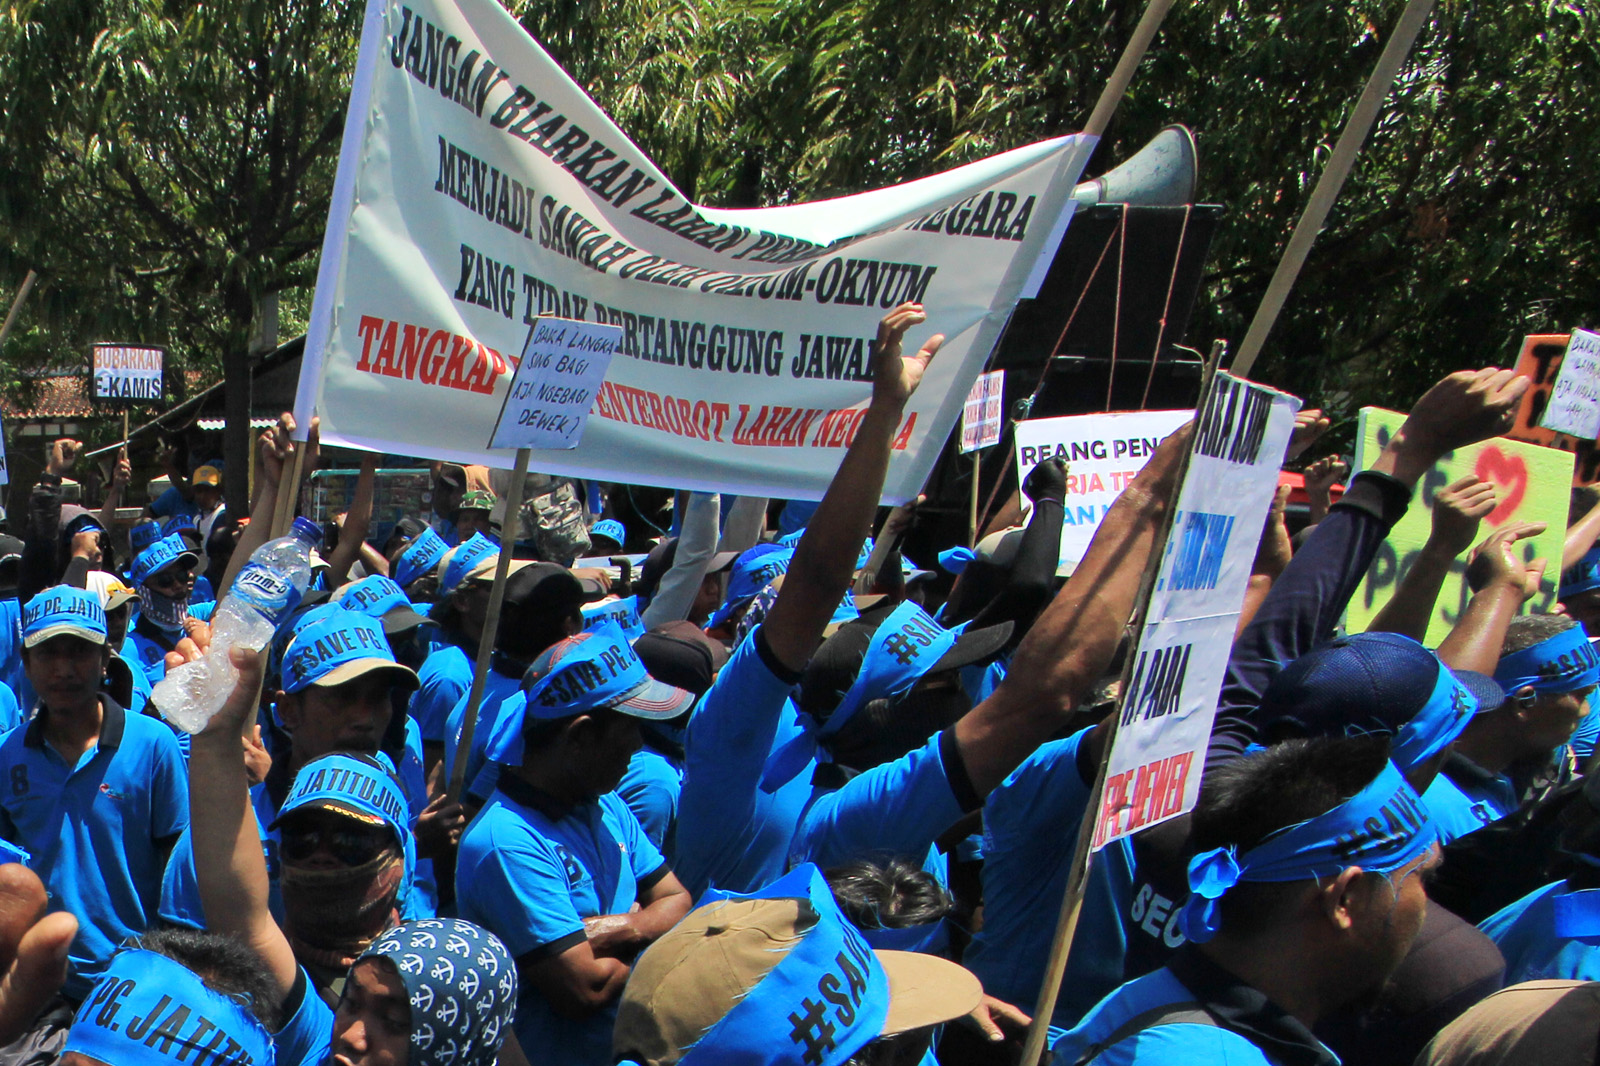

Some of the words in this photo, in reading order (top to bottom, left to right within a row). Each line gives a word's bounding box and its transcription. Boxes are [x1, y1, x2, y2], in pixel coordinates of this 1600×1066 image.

[391, 5, 510, 119] JANGAN
[490, 84, 656, 209] BIARKAN
[435, 135, 535, 239] MENJADI
[539, 195, 636, 275] SAWAH
[454, 243, 516, 319] YANG
[94, 347, 162, 369] BUBARKAN
[534, 325, 566, 346] BAKA
[567, 331, 615, 356] LANGKA
[555, 355, 590, 376] BAGI
[356, 315, 506, 396] TANGKAP
[590, 380, 729, 443] ENYEROBOT
[731, 404, 813, 449] LAHAN
[812, 407, 918, 451] NEGA
[536, 382, 589, 405] NGEBAGI
[1113, 436, 1164, 460] PEN
[887, 604, 943, 667] #SAV
[297, 768, 402, 824] JATITUJUH
